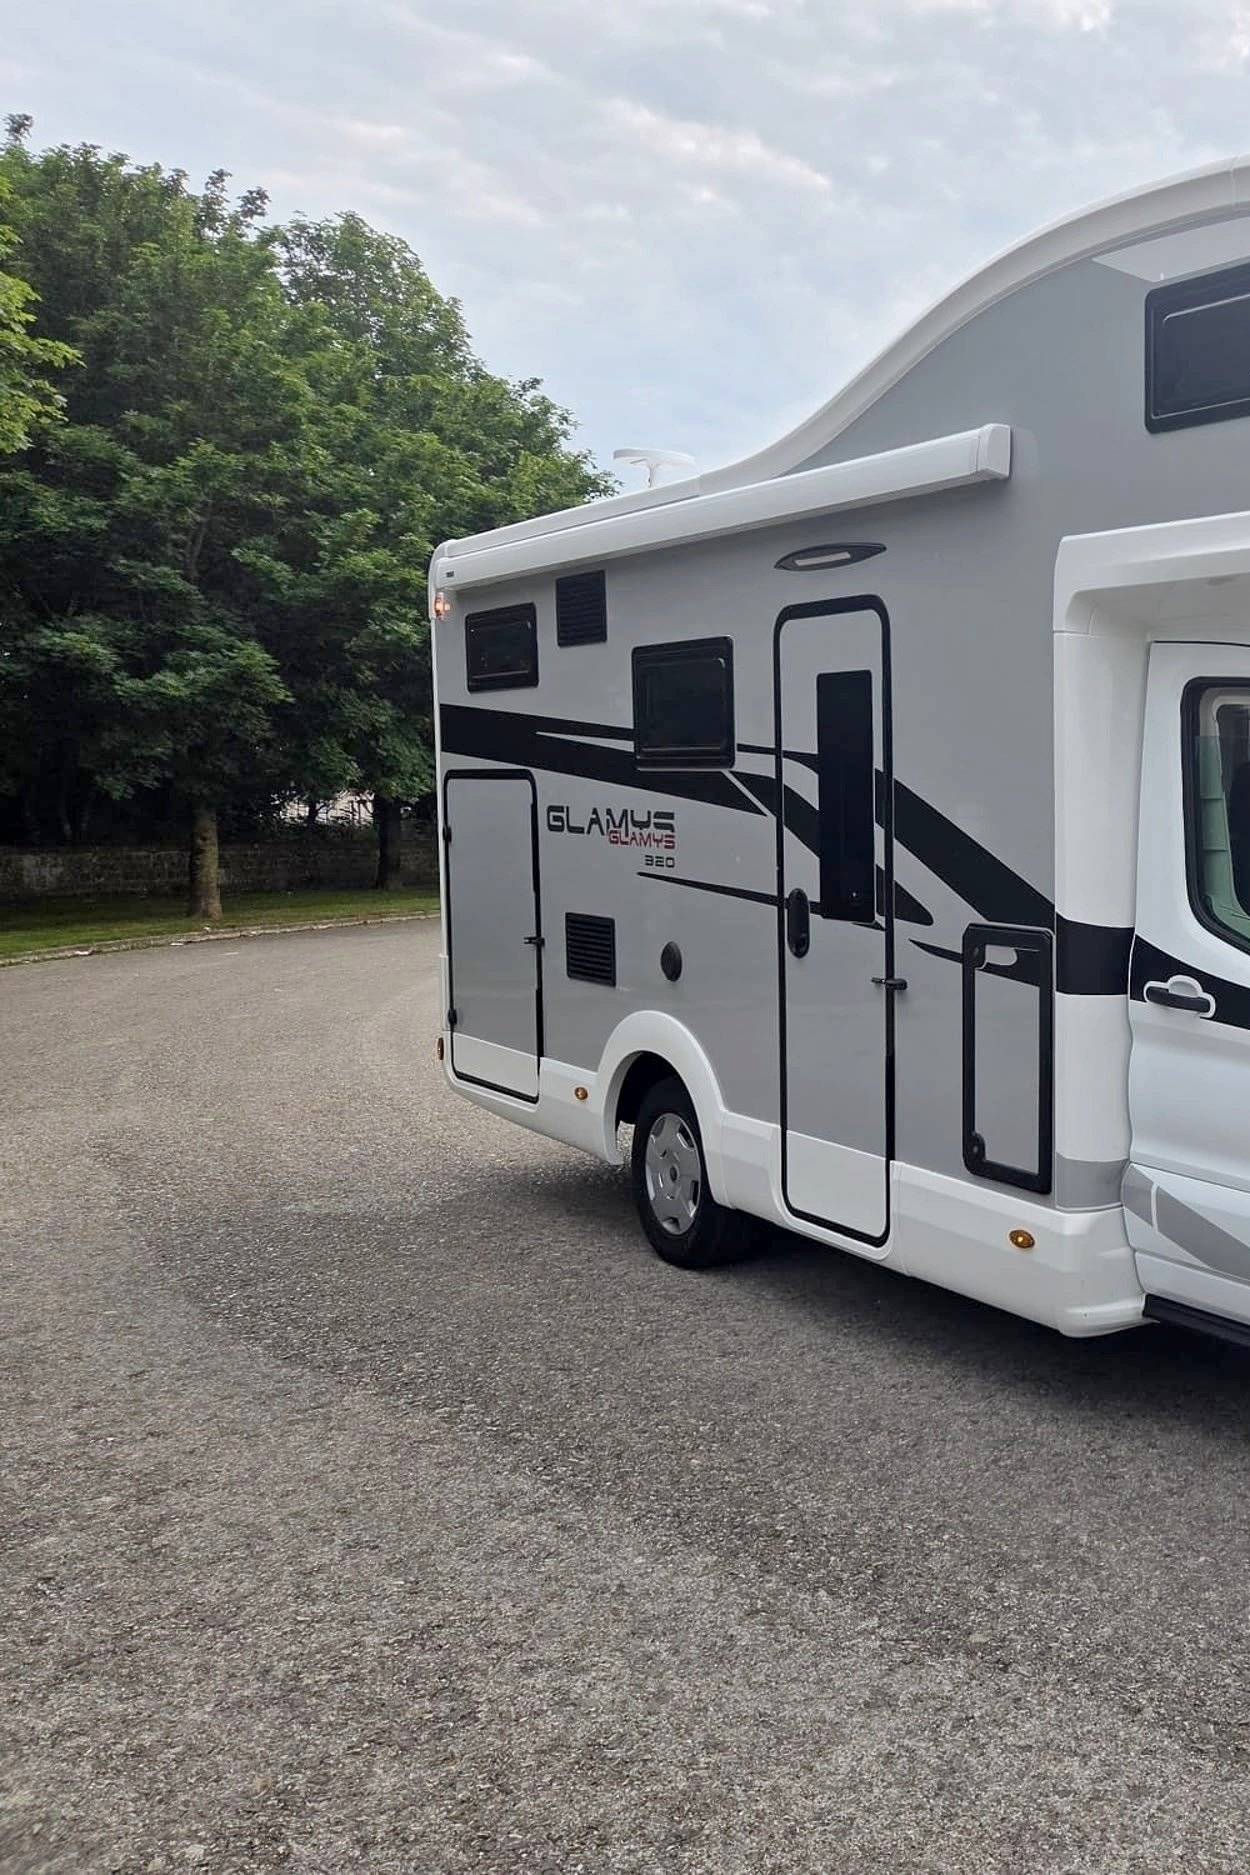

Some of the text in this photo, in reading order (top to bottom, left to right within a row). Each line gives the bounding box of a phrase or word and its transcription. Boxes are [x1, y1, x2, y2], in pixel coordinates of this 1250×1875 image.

[547, 805, 675, 837] GLAMYS
[609, 830, 675, 850] GLAMYS
[645, 855, 675, 868] 320
